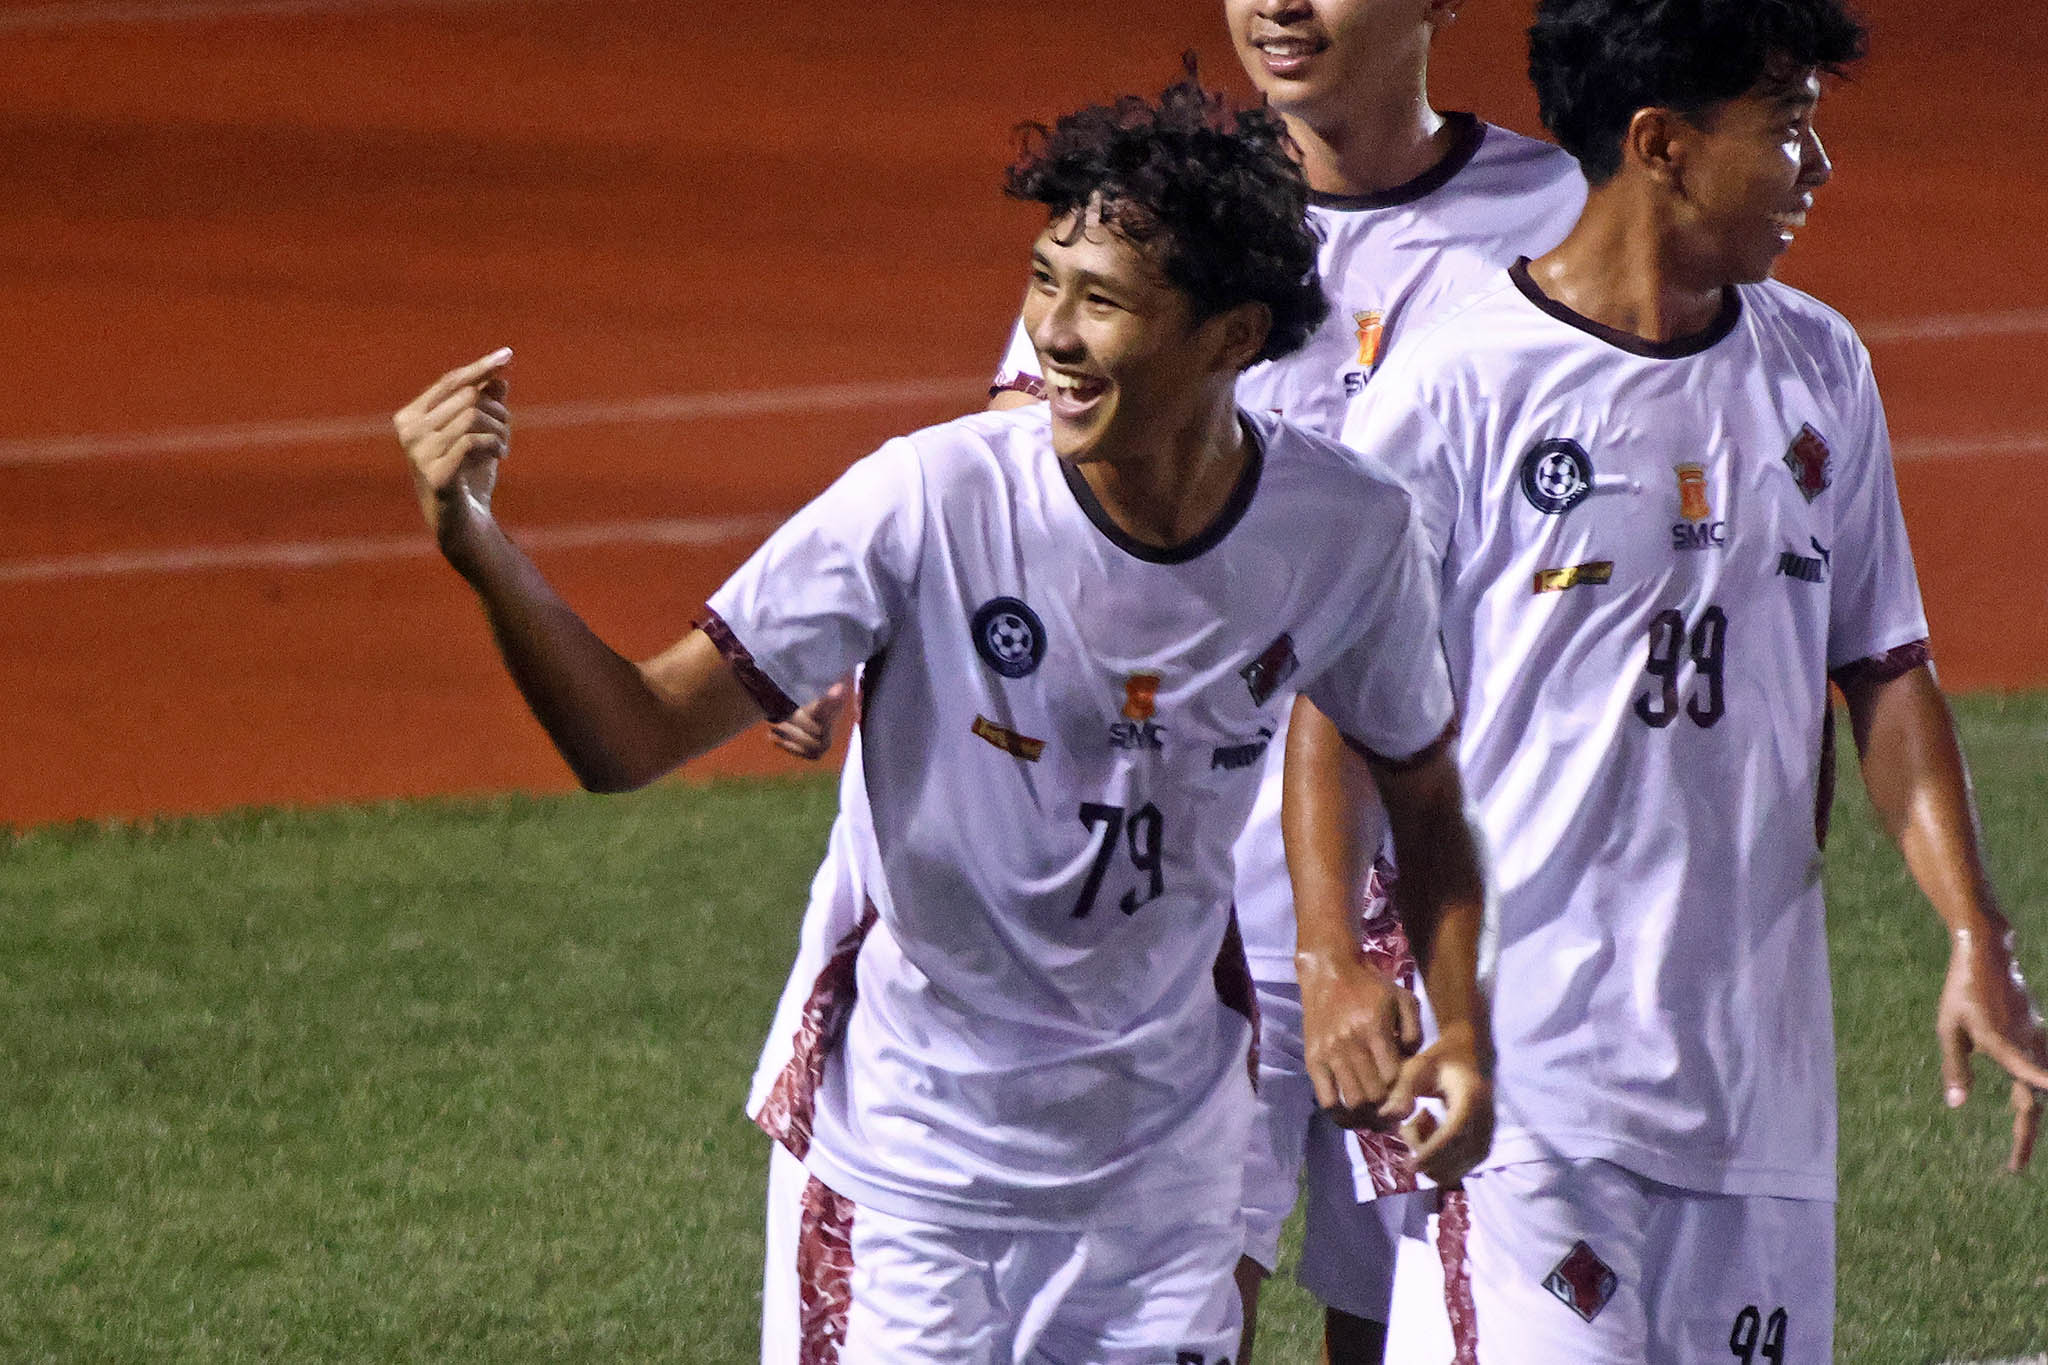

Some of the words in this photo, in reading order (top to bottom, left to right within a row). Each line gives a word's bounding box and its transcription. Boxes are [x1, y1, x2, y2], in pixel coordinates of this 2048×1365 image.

[1672, 521, 1726, 549] SMC
[1634, 605, 1728, 728] 99
[1109, 722, 1167, 750] SMC
[1073, 802, 1164, 915] 79
